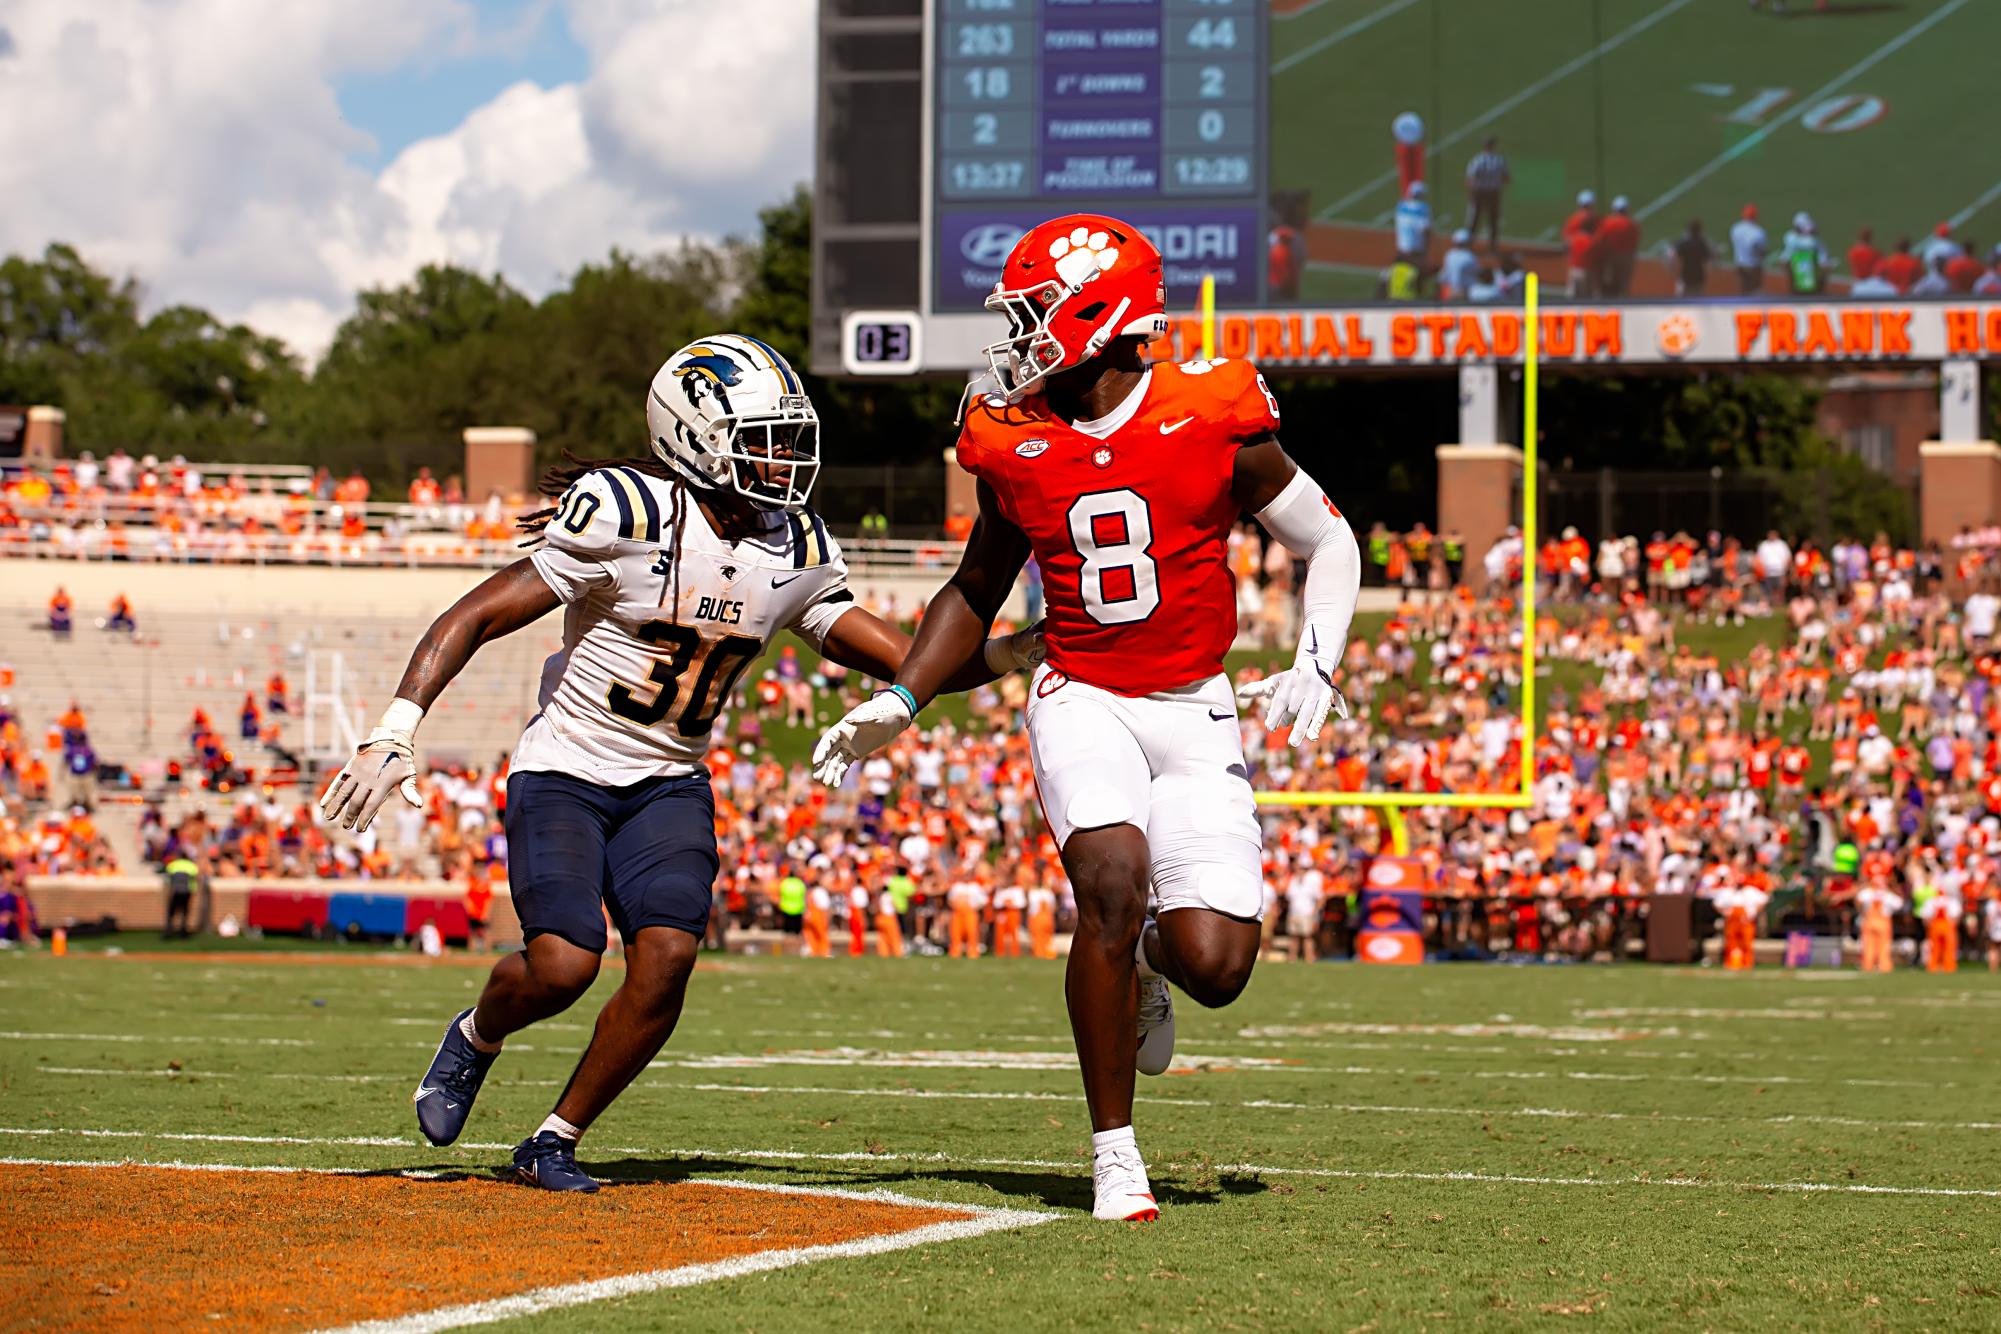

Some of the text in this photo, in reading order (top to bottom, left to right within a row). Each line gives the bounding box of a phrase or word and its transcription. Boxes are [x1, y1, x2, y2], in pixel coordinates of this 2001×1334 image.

[1187, 18, 1236, 48] 44
[965, 67, 1009, 98] 18
[1199, 66, 1225, 97] 2
[974, 114, 998, 144] 2
[1199, 110, 1224, 141] 0
[859, 325, 909, 361] 03
[1137, 313, 1372, 360] EMORIAL
[1391, 311, 1622, 358] STADUM
[1735, 309, 1912, 356] FRANK
[1066, 487, 1162, 626] 8
[695, 596, 743, 624] BUCS
[605, 618, 765, 738] 30
